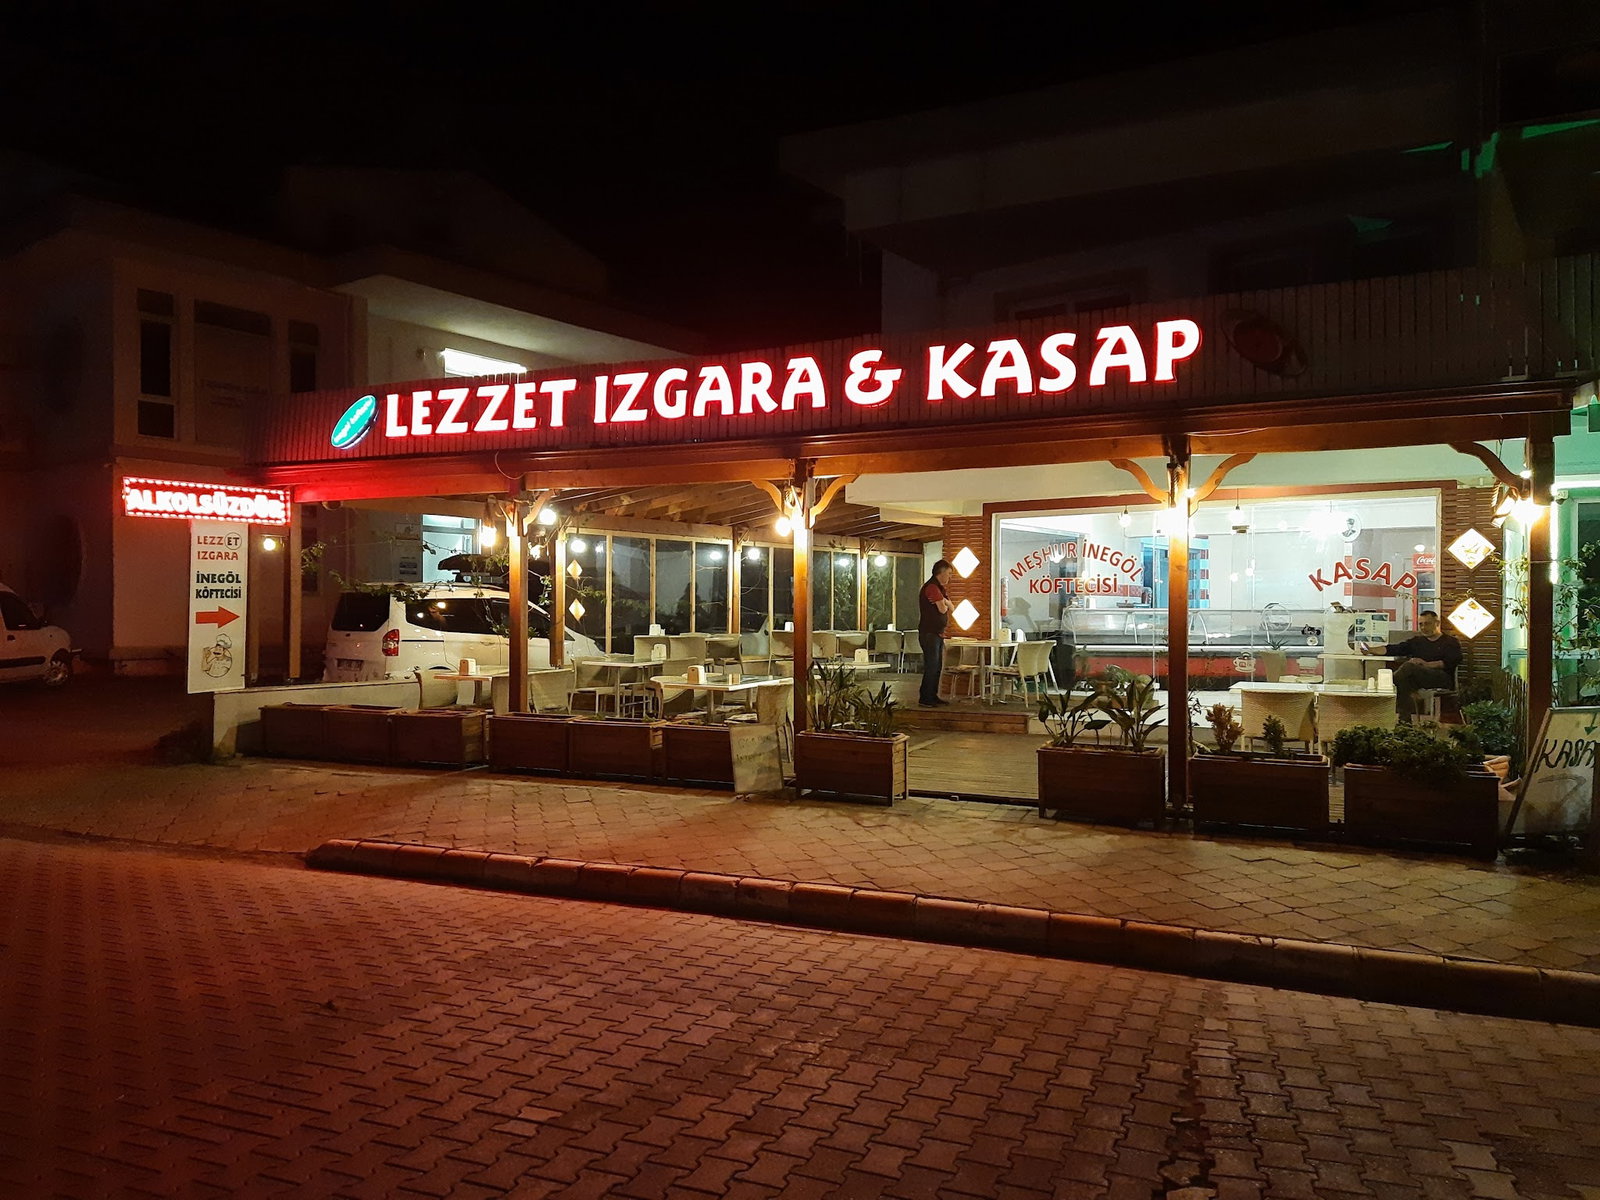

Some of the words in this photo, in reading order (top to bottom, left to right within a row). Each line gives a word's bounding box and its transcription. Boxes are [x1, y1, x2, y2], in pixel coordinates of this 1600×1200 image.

[385, 378, 577, 438] LEZZET
[593, 356, 827, 424] IZGARA
[844, 349, 903, 407] &
[926, 318, 1202, 402] KASAP
[196, 550, 239, 561] IZGARA
[1009, 541, 1078, 582] MEŞHUR
[1082, 538, 1143, 583] İNEGÖL
[195, 570, 242, 584] İNEGÖL
[1029, 573, 1118, 594] KÖFTECİSİ
[1308, 558, 1417, 592] KASAP
[195, 585, 242, 599] KÖFTECİSİ
[1534, 738, 1596, 774] KASA
